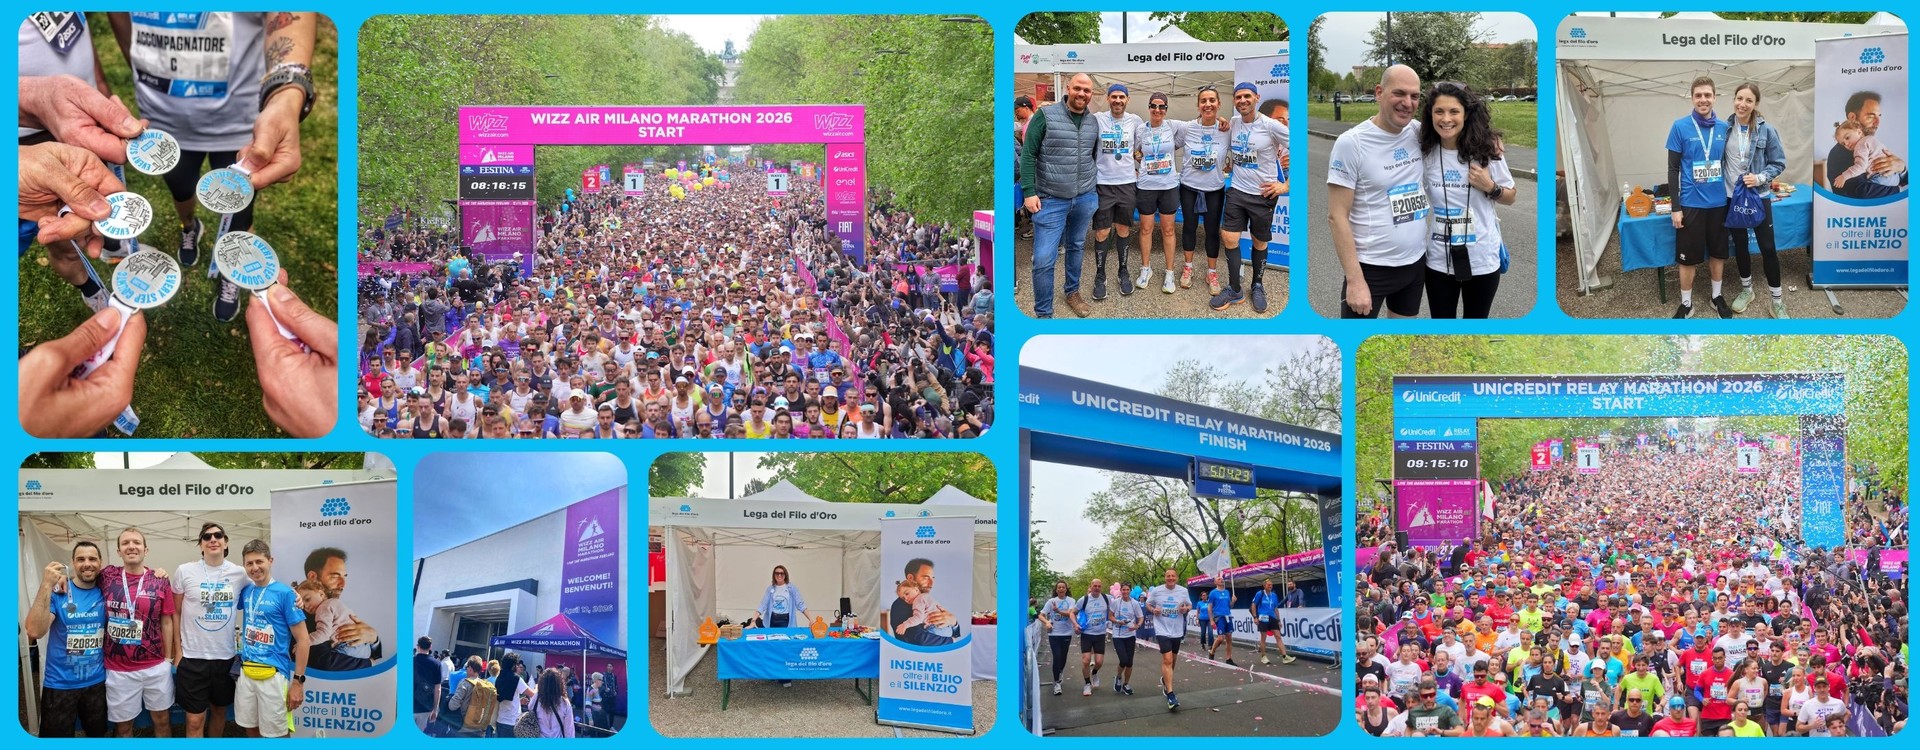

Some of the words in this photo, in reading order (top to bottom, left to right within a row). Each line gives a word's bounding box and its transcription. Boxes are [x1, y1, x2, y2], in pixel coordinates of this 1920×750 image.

[136, 30, 226, 53] ACCOMPAGNATORE
[1662, 33, 1696, 47] Lega
[1700, 34, 1720, 45] del
[1724, 34, 1748, 45] Filo
[1751, 34, 1786, 45] d'Oro
[1127, 53, 1152, 63] Lega
[1155, 53, 1171, 62] del
[1173, 53, 1193, 61] Filo
[1196, 52, 1225, 61] d'Oro
[170, 57, 178, 71] C
[1841, 67, 1856, 75] lega
[530, 113, 570, 125] WIZZ
[574, 113, 600, 125] AIR
[604, 113, 663, 125] MILANO
[667, 112, 751, 125] MARATHON
[756, 112, 792, 124] 2026
[638, 127, 685, 138] START
[479, 166, 514, 174] FESTINA
[471, 181, 526, 190] 08:16:15
[587, 177, 595, 188] 2
[631, 178, 636, 190] 1
[774, 178, 780, 190] 1
[835, 178, 856, 186] enel
[838, 221, 853, 233] FIAT
[1827, 216, 1887, 228] INSIEME
[1841, 230, 1864, 239] oltre
[1866, 230, 1871, 238] il
[1873, 228, 1908, 238] BUIO
[252, 239, 274, 261] EVERY
[1826, 241, 1832, 249] e
[1834, 241, 1840, 249] il
[1842, 239, 1902, 249] SILENZIO
[263, 261, 276, 280] STEP
[231, 268, 265, 286] COUNTS
[160, 273, 177, 298] EVERY
[134, 292, 157, 305] STEP
[1472, 382, 1561, 395] UNICREDIT
[1566, 382, 1619, 395] RELAY
[1624, 381, 1718, 395] MARATHON
[1721, 380, 1763, 393] 2026
[1415, 391, 1461, 402] UniCredit
[1592, 397, 1645, 410] START
[1072, 390, 1171, 422] UNICREDIT
[1174, 411, 1223, 432] RELAY
[1227, 422, 1301, 447] MARATHON
[1303, 437, 1331, 452] 2026
[1408, 428, 1436, 436] UniCredit
[1199, 432, 1247, 452] FINISH
[1416, 442, 1455, 450] FESTINA
[1406, 459, 1468, 468] 09:15:10
[1536, 452, 1546, 465] 2
[1584, 454, 1590, 466] 1
[118, 483, 155, 498] Lega
[159, 483, 181, 496] del
[185, 483, 212, 496] Filo
[215, 483, 254, 496] d'Oro
[743, 509, 768, 519] Lega
[770, 510, 786, 519] del
[789, 511, 807, 519] Filo
[809, 511, 837, 520] d'Oro
[299, 520, 317, 529] lega
[318, 519, 331, 527] del
[333, 518, 347, 526] filo
[349, 517, 372, 526] d'oro
[577, 543, 605, 553] MILANO
[567, 572, 611, 585] WELCOME!
[564, 581, 613, 593] BENVENUTI!
[74, 611, 99, 619] UniCredit
[72, 637, 99, 649] 2082A
[890, 659, 943, 673] INSIEME
[902, 672, 923, 680] oltre
[925, 673, 929, 681] il
[932, 673, 962, 684] BUIO
[903, 680, 957, 694] SILENZIO
[302, 706, 328, 716] oltre
[331, 707, 337, 716] il
[341, 706, 383, 721] BUIO
[303, 716, 376, 733] SILENZIO
